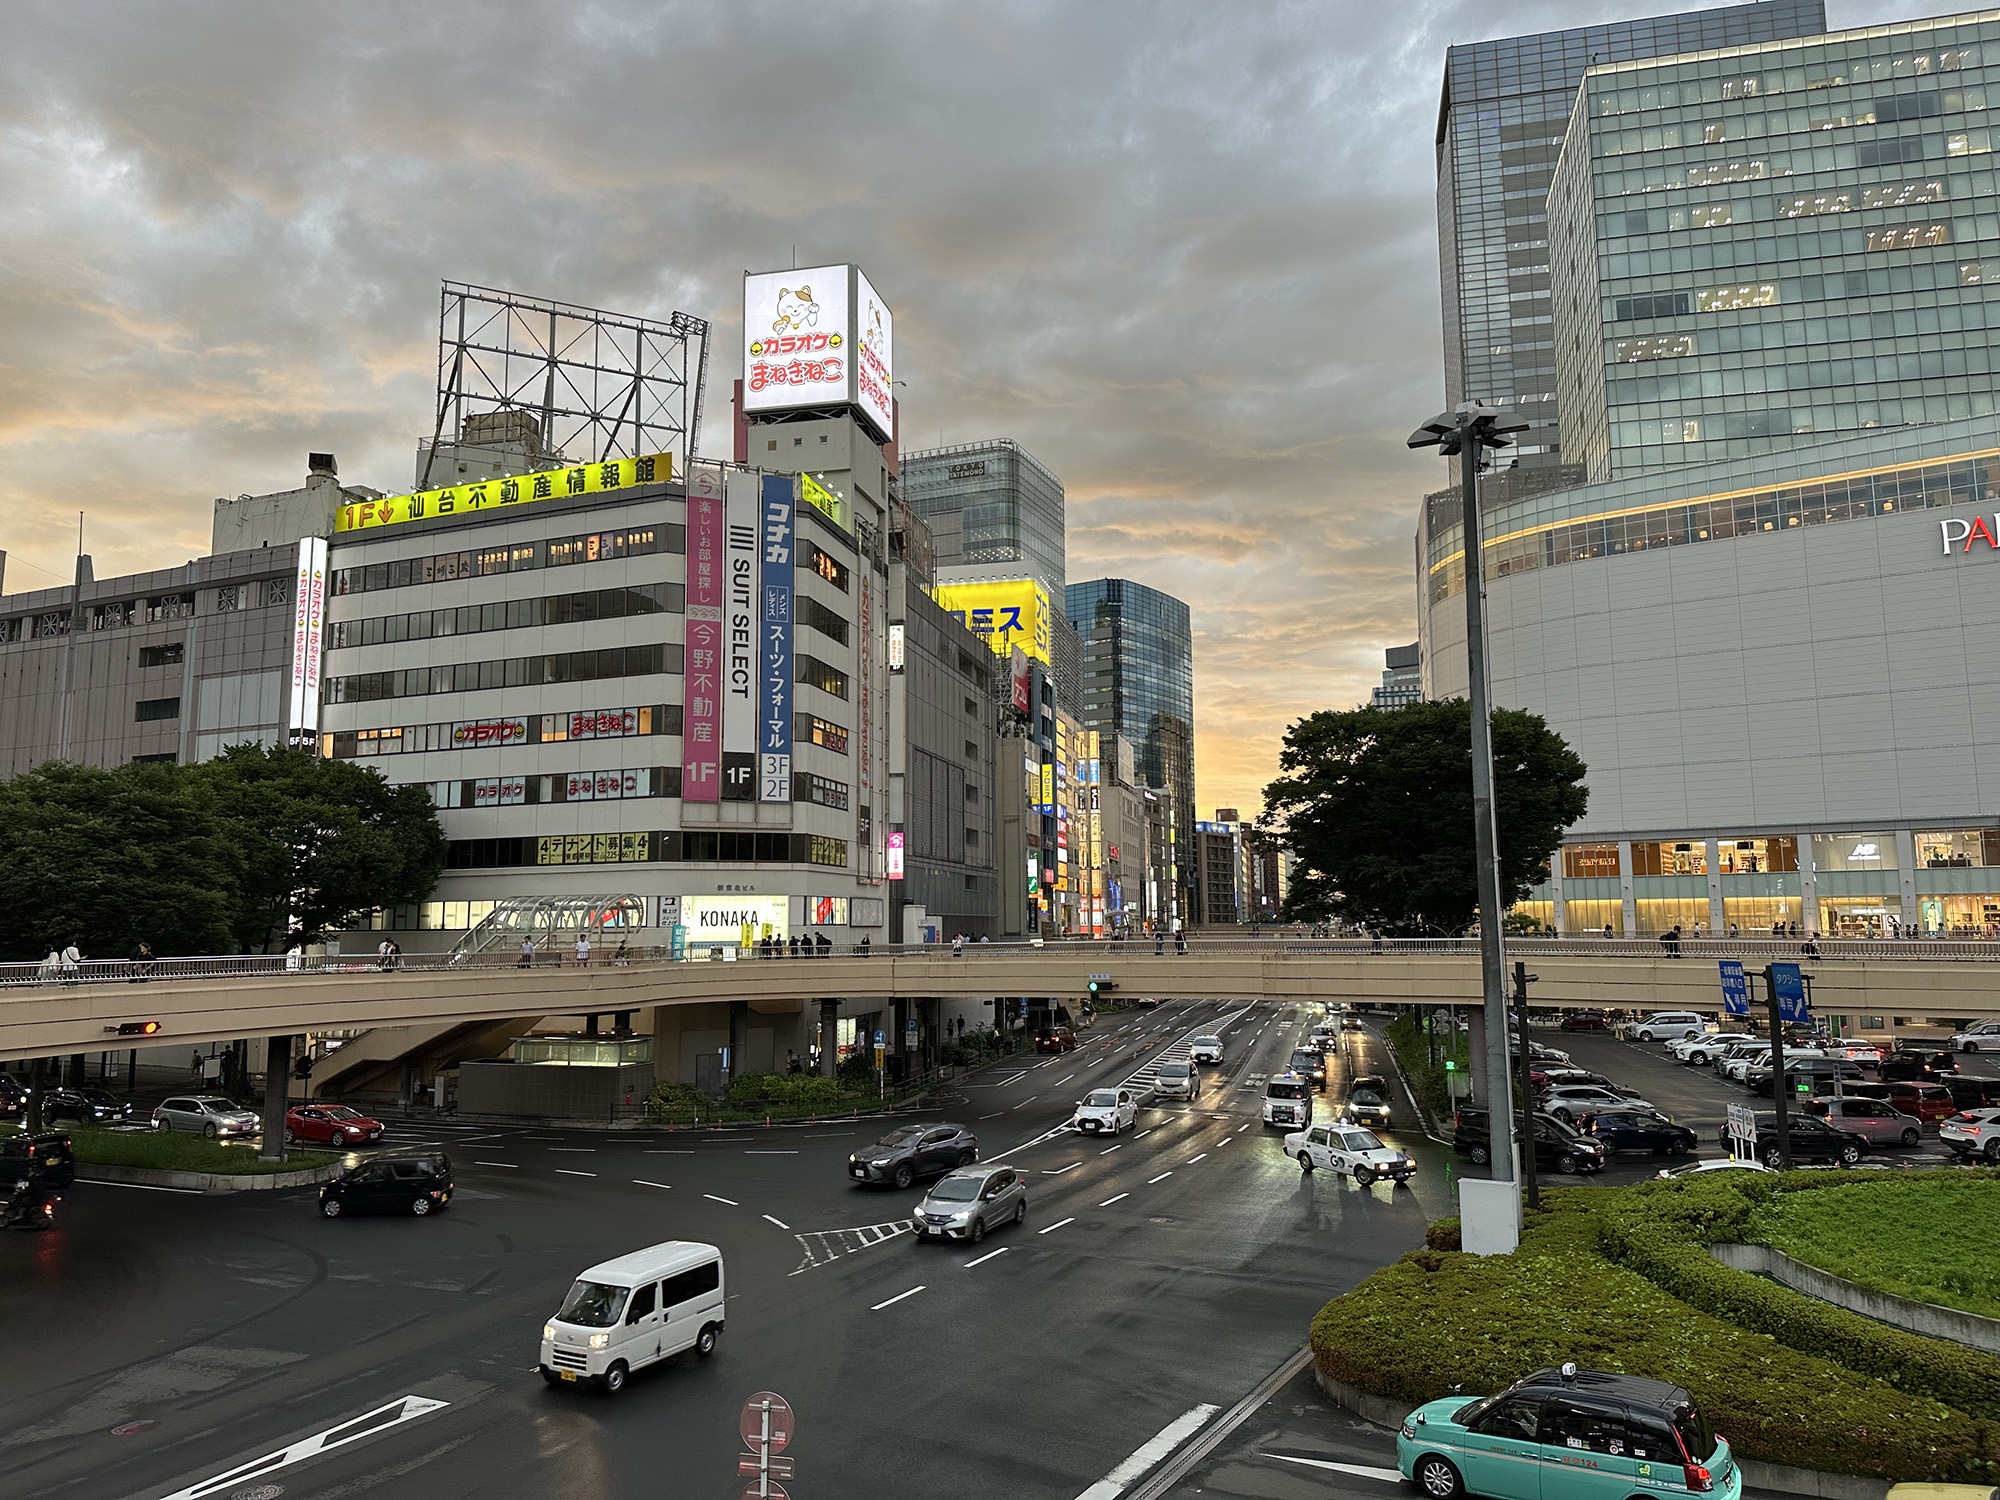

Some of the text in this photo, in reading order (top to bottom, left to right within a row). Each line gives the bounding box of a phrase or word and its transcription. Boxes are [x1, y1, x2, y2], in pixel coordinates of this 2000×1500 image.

[763, 332, 829, 356] カラオケ
[749, 358, 844, 391] まねきねこ
[863, 344, 887, 381] カラオケ
[859, 363, 891, 420] まねきねこ
[949, 462, 984, 472] TOKYO
[949, 469, 984, 479] TATEMONO
[345, 457, 657, 529] 1F 仙台不動産情報館
[765, 502, 790, 564] コナカ
[698, 501, 712, 603] 楽しいお部屋探し
[297, 578, 308, 620] カラオケ
[310, 578, 323, 620] カラオケ
[731, 558, 750, 699] SUIT SELECT
[692, 624, 715, 743] 今野不動産
[767, 625, 785, 749] スーツ・フォーマル
[463, 723, 516, 742] カラオケ
[570, 712, 636, 738] まねきねこ
[686, 761, 717, 782] 1F
[726, 767, 751, 784] 1F
[766, 756, 789, 775] 3F
[476, 783, 525, 798] カラオケ
[568, 776, 637, 796] まねきねこ
[766, 780, 788, 798] 2F
[551, 836, 634, 852] テナント募集
[700, 910, 759, 927] KONAKA
[1776, 973, 1799, 985] タクシー
